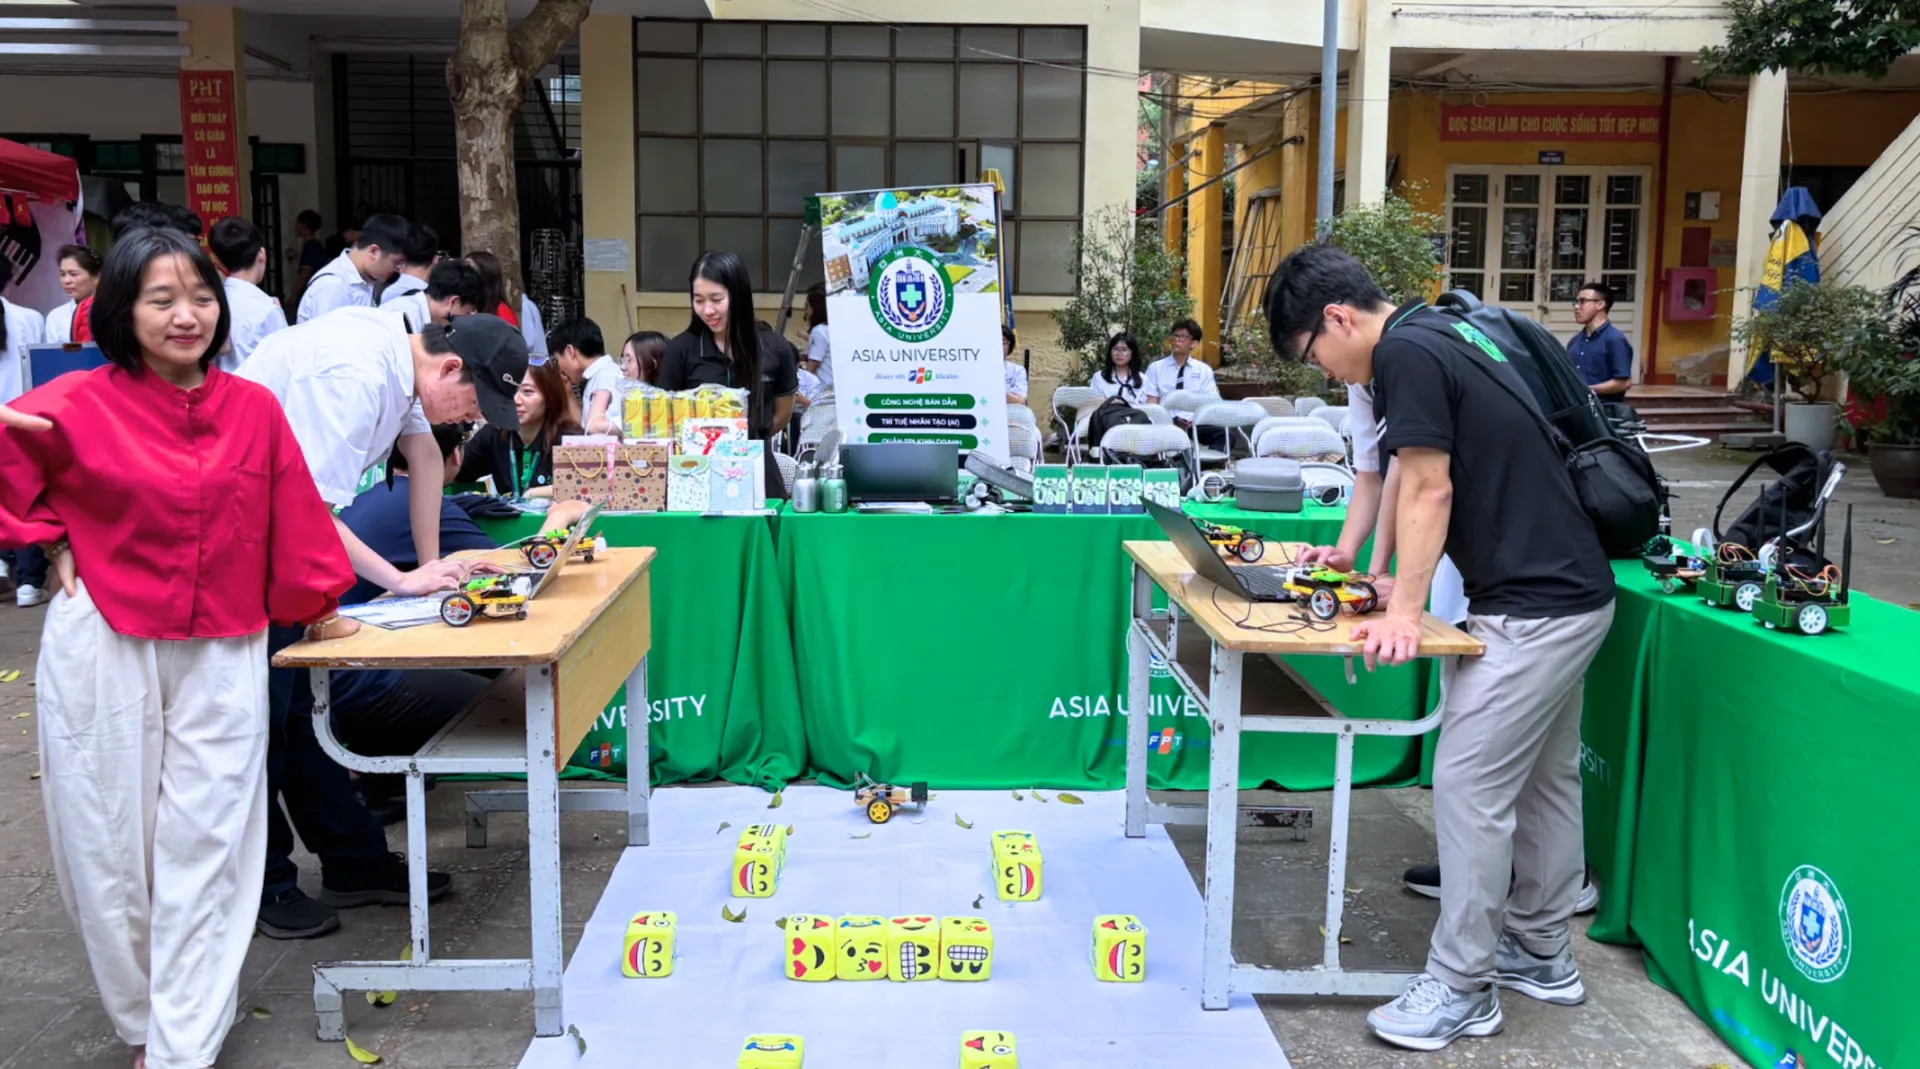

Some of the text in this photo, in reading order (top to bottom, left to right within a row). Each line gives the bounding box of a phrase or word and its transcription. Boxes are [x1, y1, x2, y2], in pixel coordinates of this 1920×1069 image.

[1469, 113, 1496, 133] SÁCH
[1497, 113, 1519, 133] LÀM
[1520, 116, 1540, 132] CHO
[1569, 112, 1597, 133] SỐNG
[1599, 112, 1616, 133] TỐT
[205, 147, 216, 160] LÀ
[873, 307, 951, 342] ASIA UNIVERSITY
[851, 348, 981, 362] ASIA UNIVERSITY
[881, 397, 902, 406] CÔNG
[902, 397, 924, 407] NGHỆ
[881, 417, 893, 426] TRÍ
[909, 416, 931, 426] NHÂN
[932, 418, 947, 428] TẠO
[1049, 694, 1111, 718] ASIA
[1148, 732, 1183, 749] FPT
[590, 746, 622, 764] FPT
